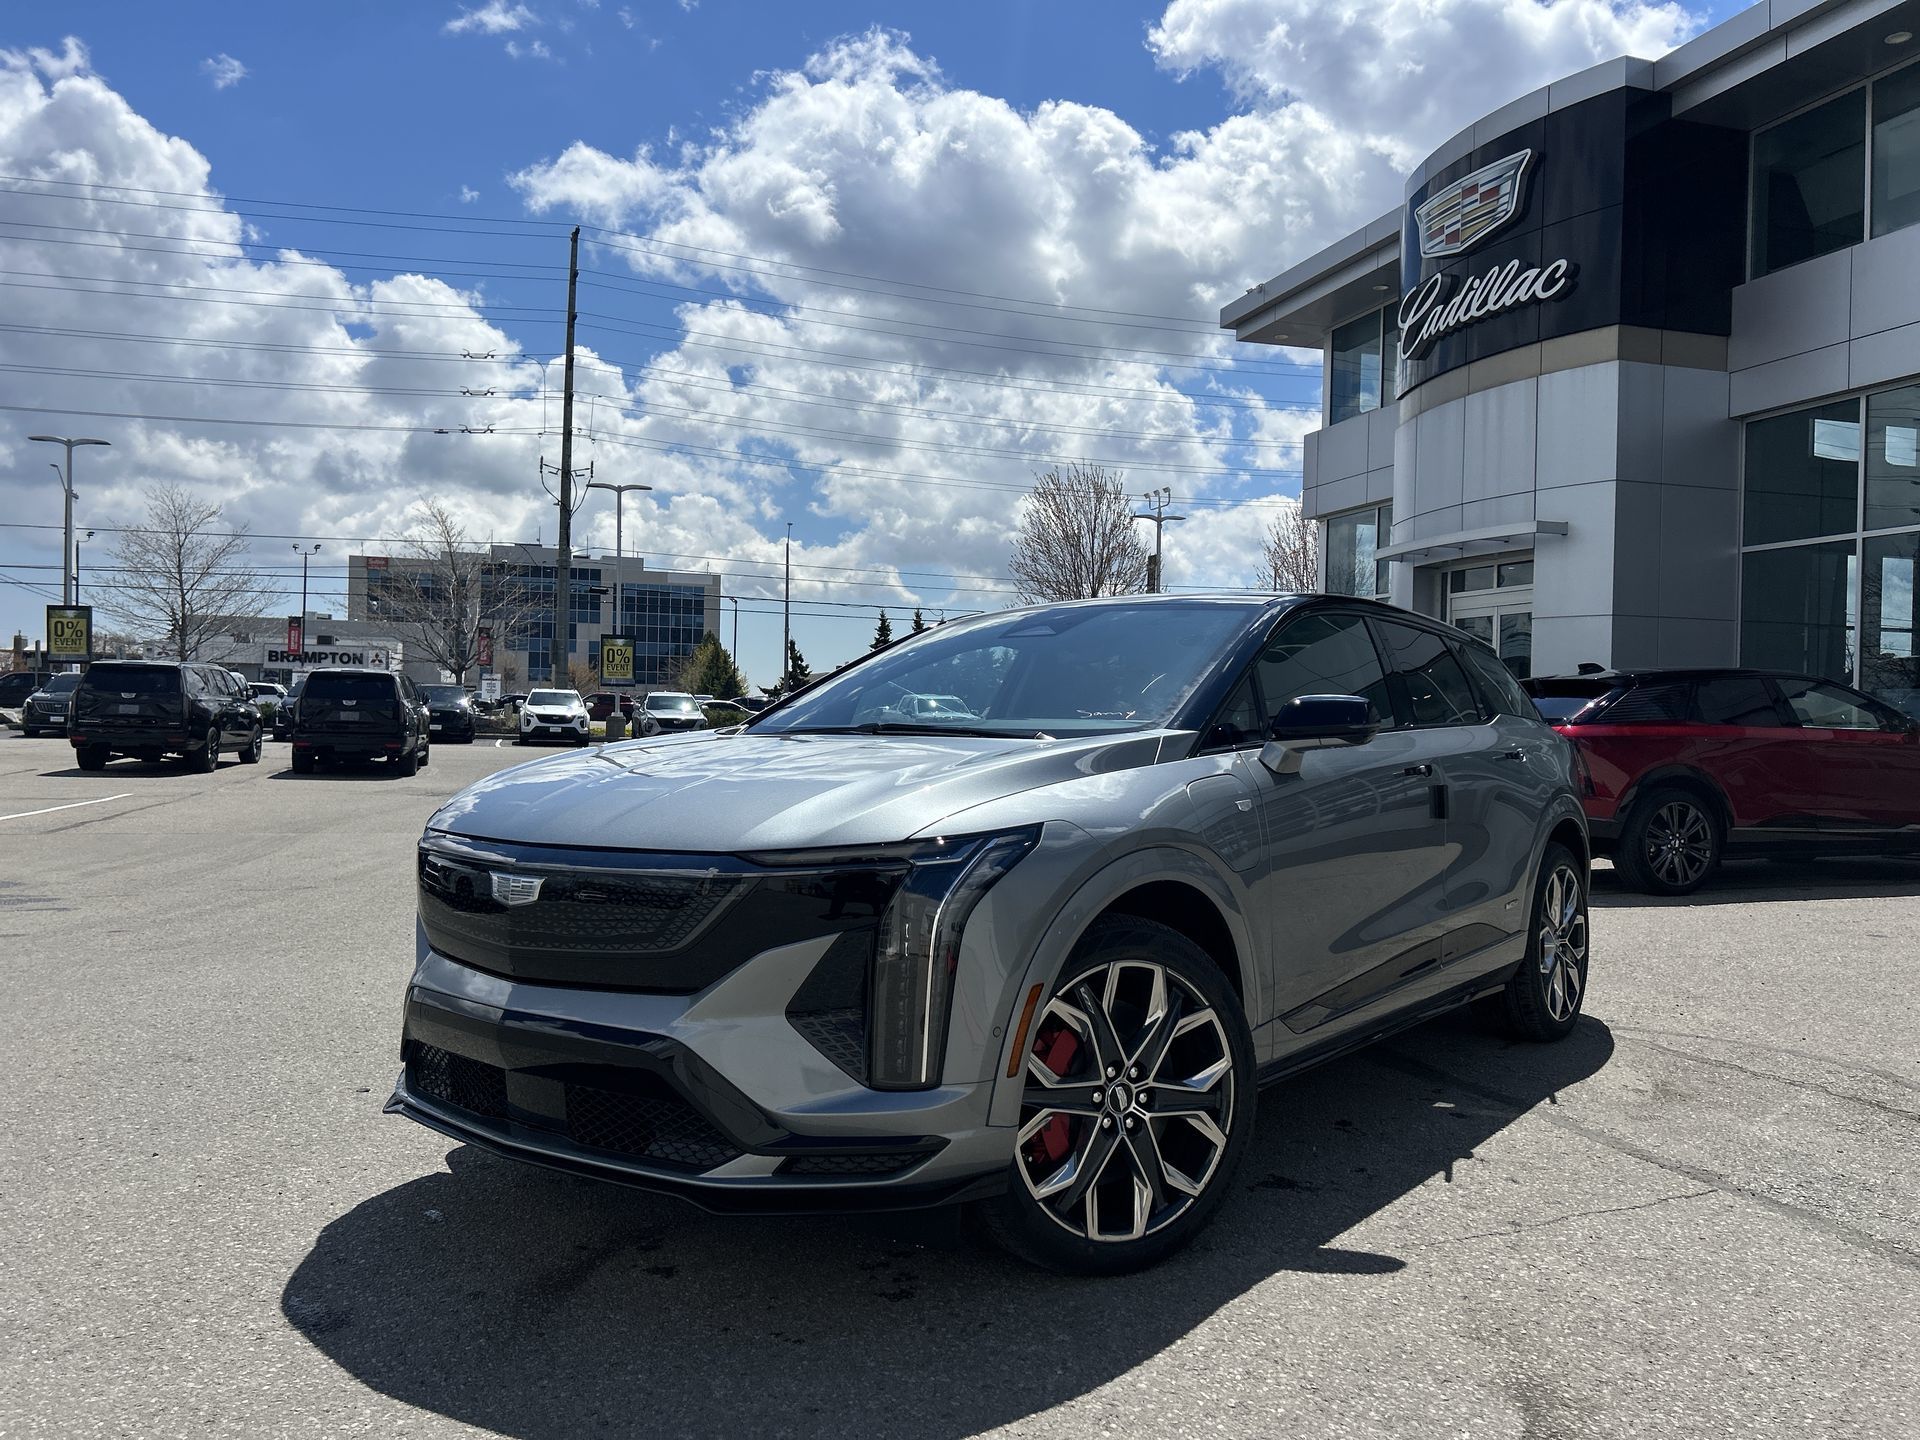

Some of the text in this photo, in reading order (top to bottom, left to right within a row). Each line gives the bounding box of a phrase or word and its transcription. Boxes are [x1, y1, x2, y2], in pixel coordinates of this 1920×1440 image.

[1398, 258, 1568, 360] Cadillac
[54, 621, 84, 638] 0%
[55, 638, 83, 646] EVENT
[268, 650, 364, 665] BRAMPTON
[606, 648, 630, 664] 0%
